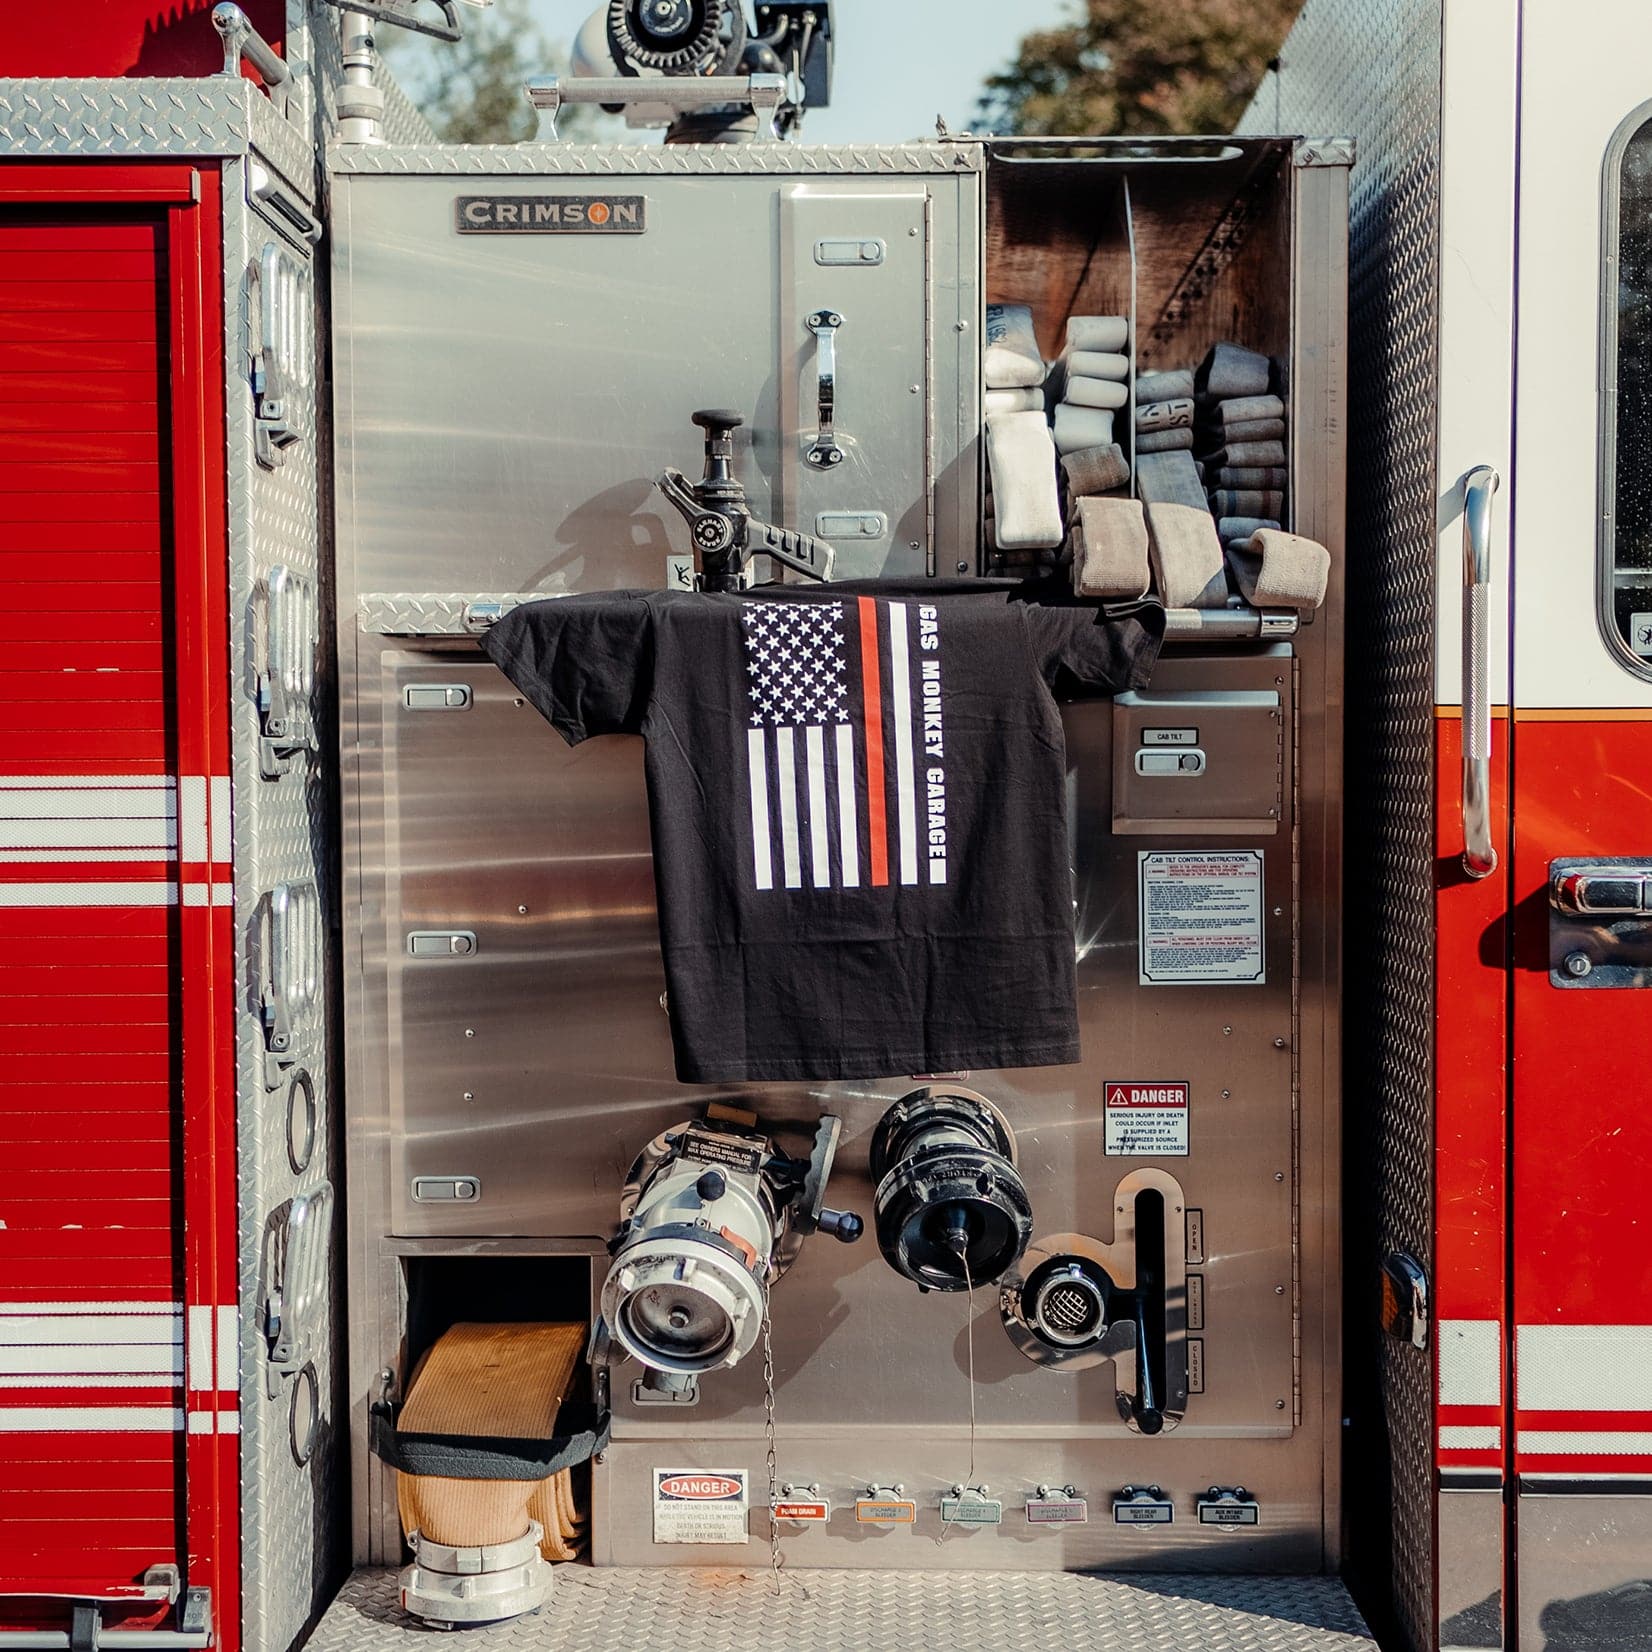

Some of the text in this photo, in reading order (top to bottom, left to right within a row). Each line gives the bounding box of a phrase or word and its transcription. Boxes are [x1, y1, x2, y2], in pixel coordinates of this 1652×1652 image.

[466, 201, 636, 224] CRIMSON
[918, 604, 946, 858] GAS MONKEY GARAGE
[1131, 1089, 1184, 1103] DANGER
[671, 1482, 730, 1493] DANGER
